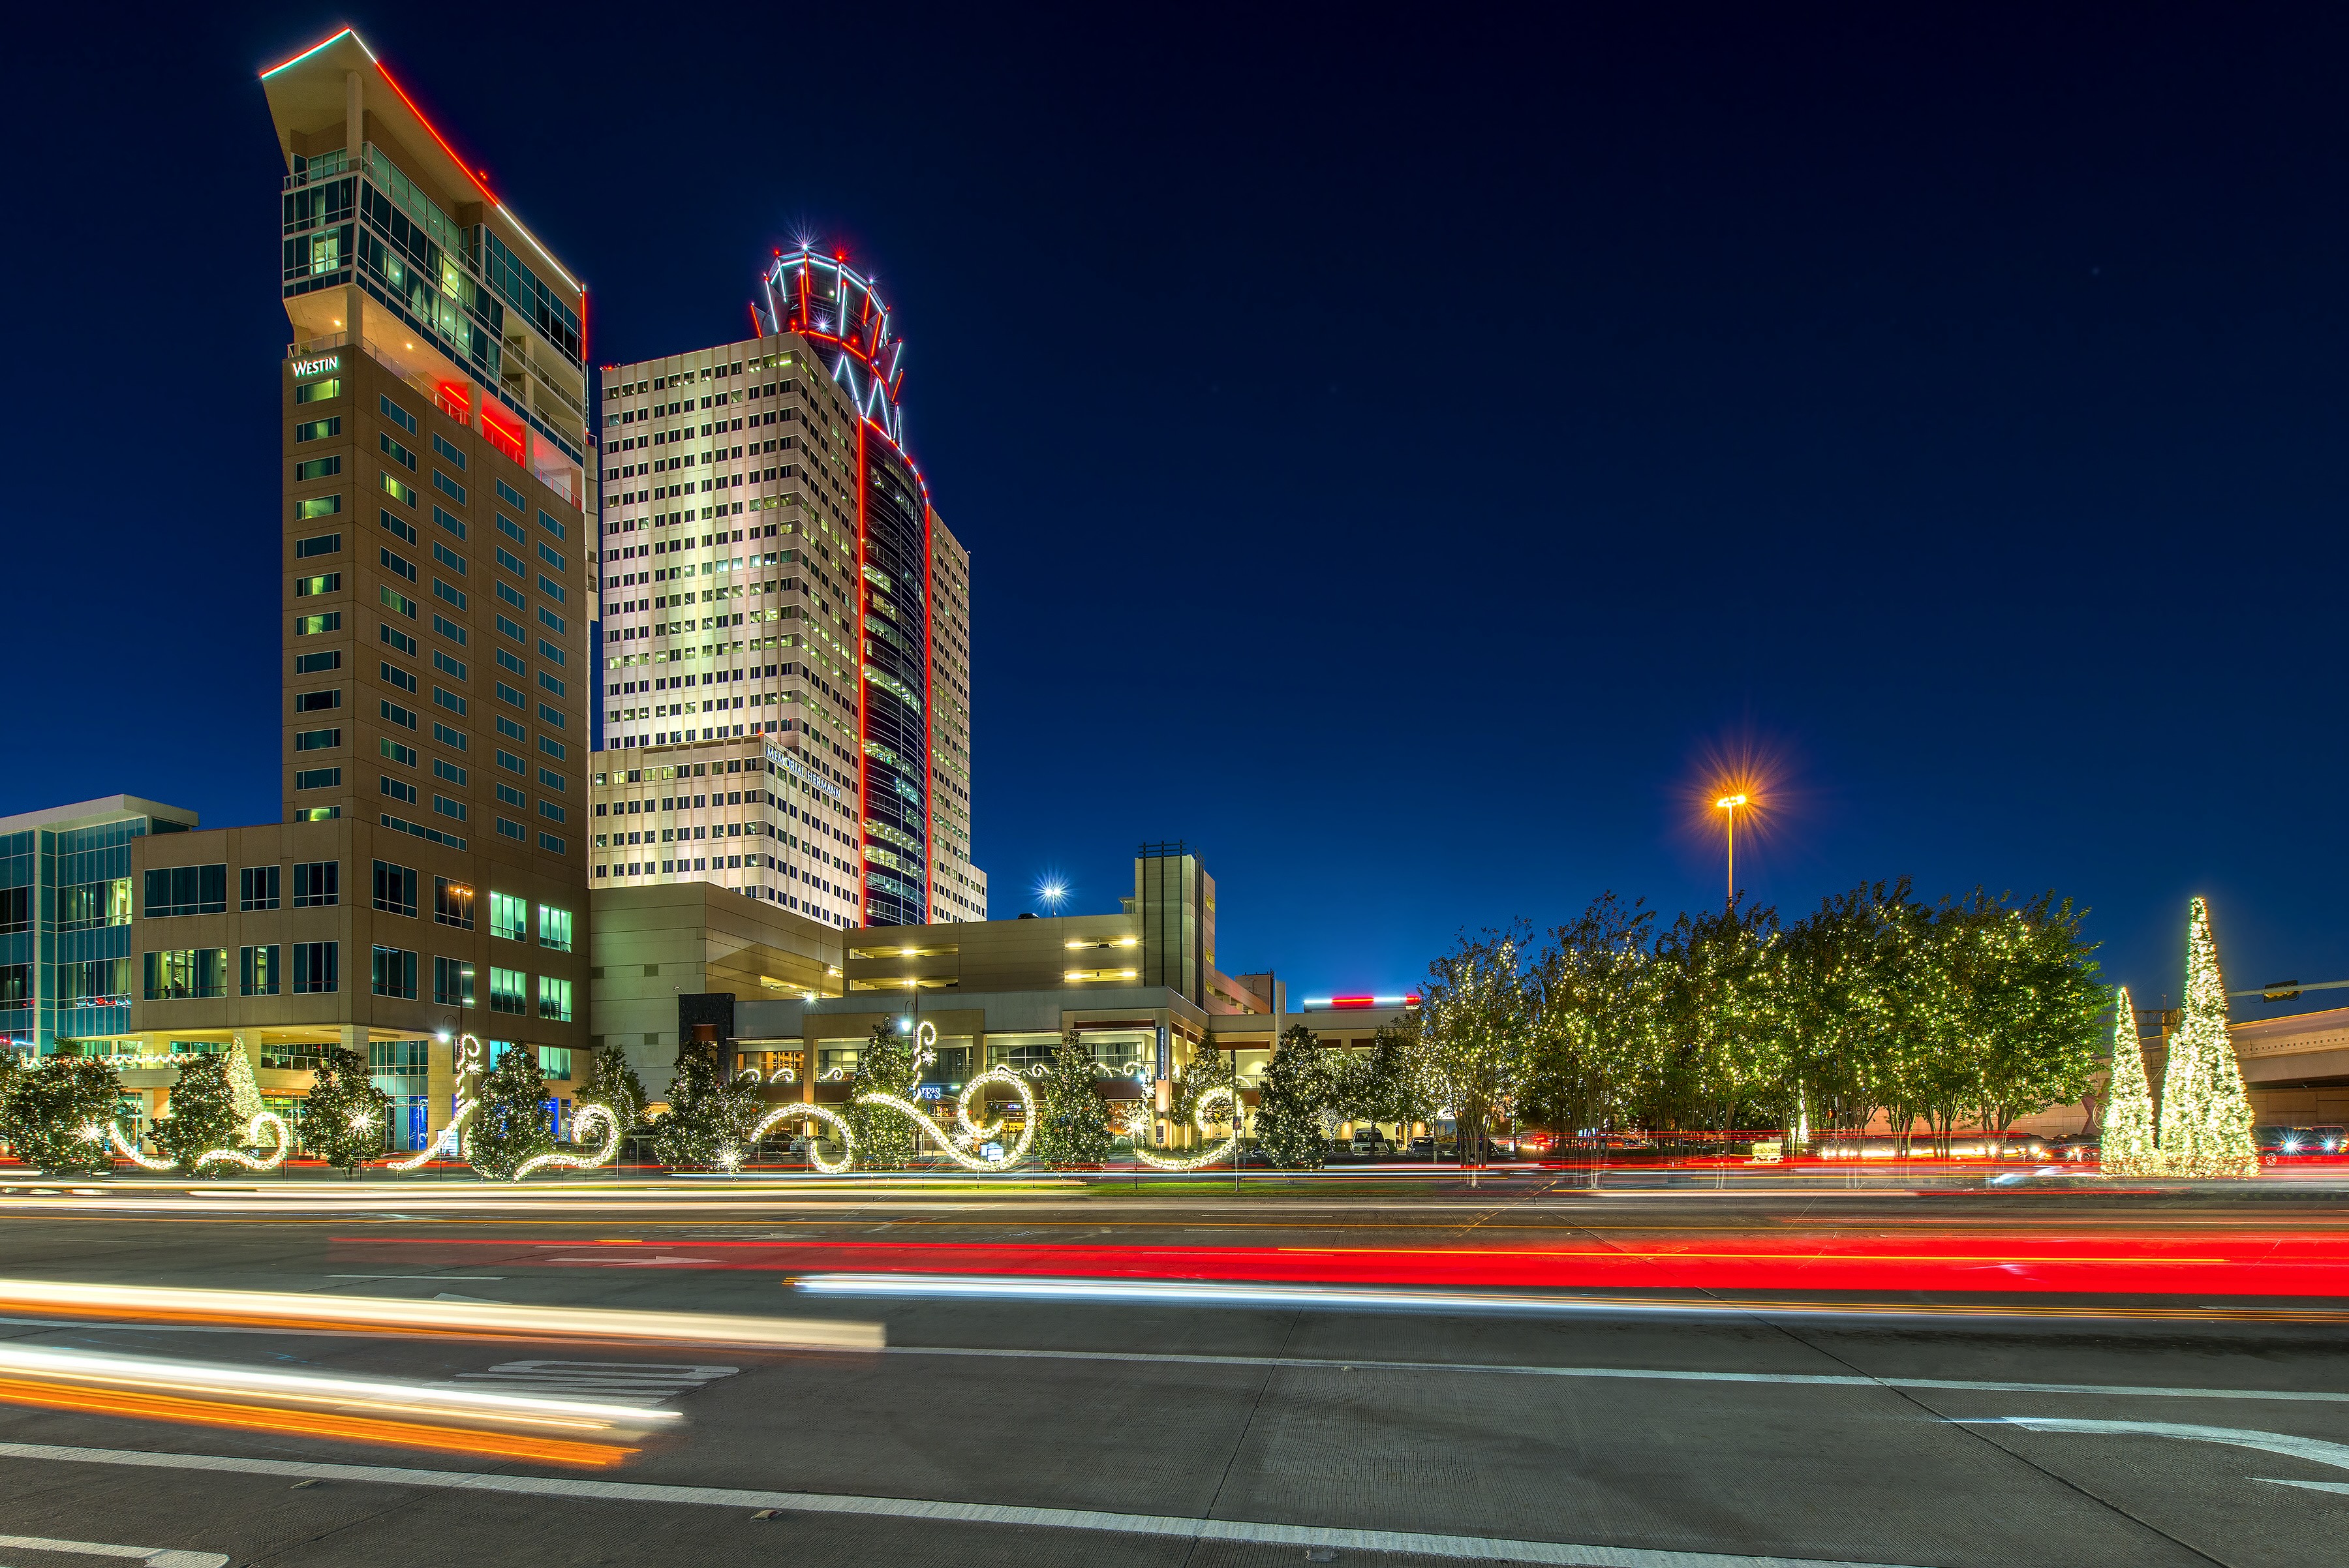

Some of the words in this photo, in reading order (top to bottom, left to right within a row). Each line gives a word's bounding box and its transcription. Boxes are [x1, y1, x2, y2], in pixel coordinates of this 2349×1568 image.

[292, 356, 338, 377] WESTIN
[766, 746, 805, 778] MEMORIAL
[806, 770, 841, 799] HERMANN
